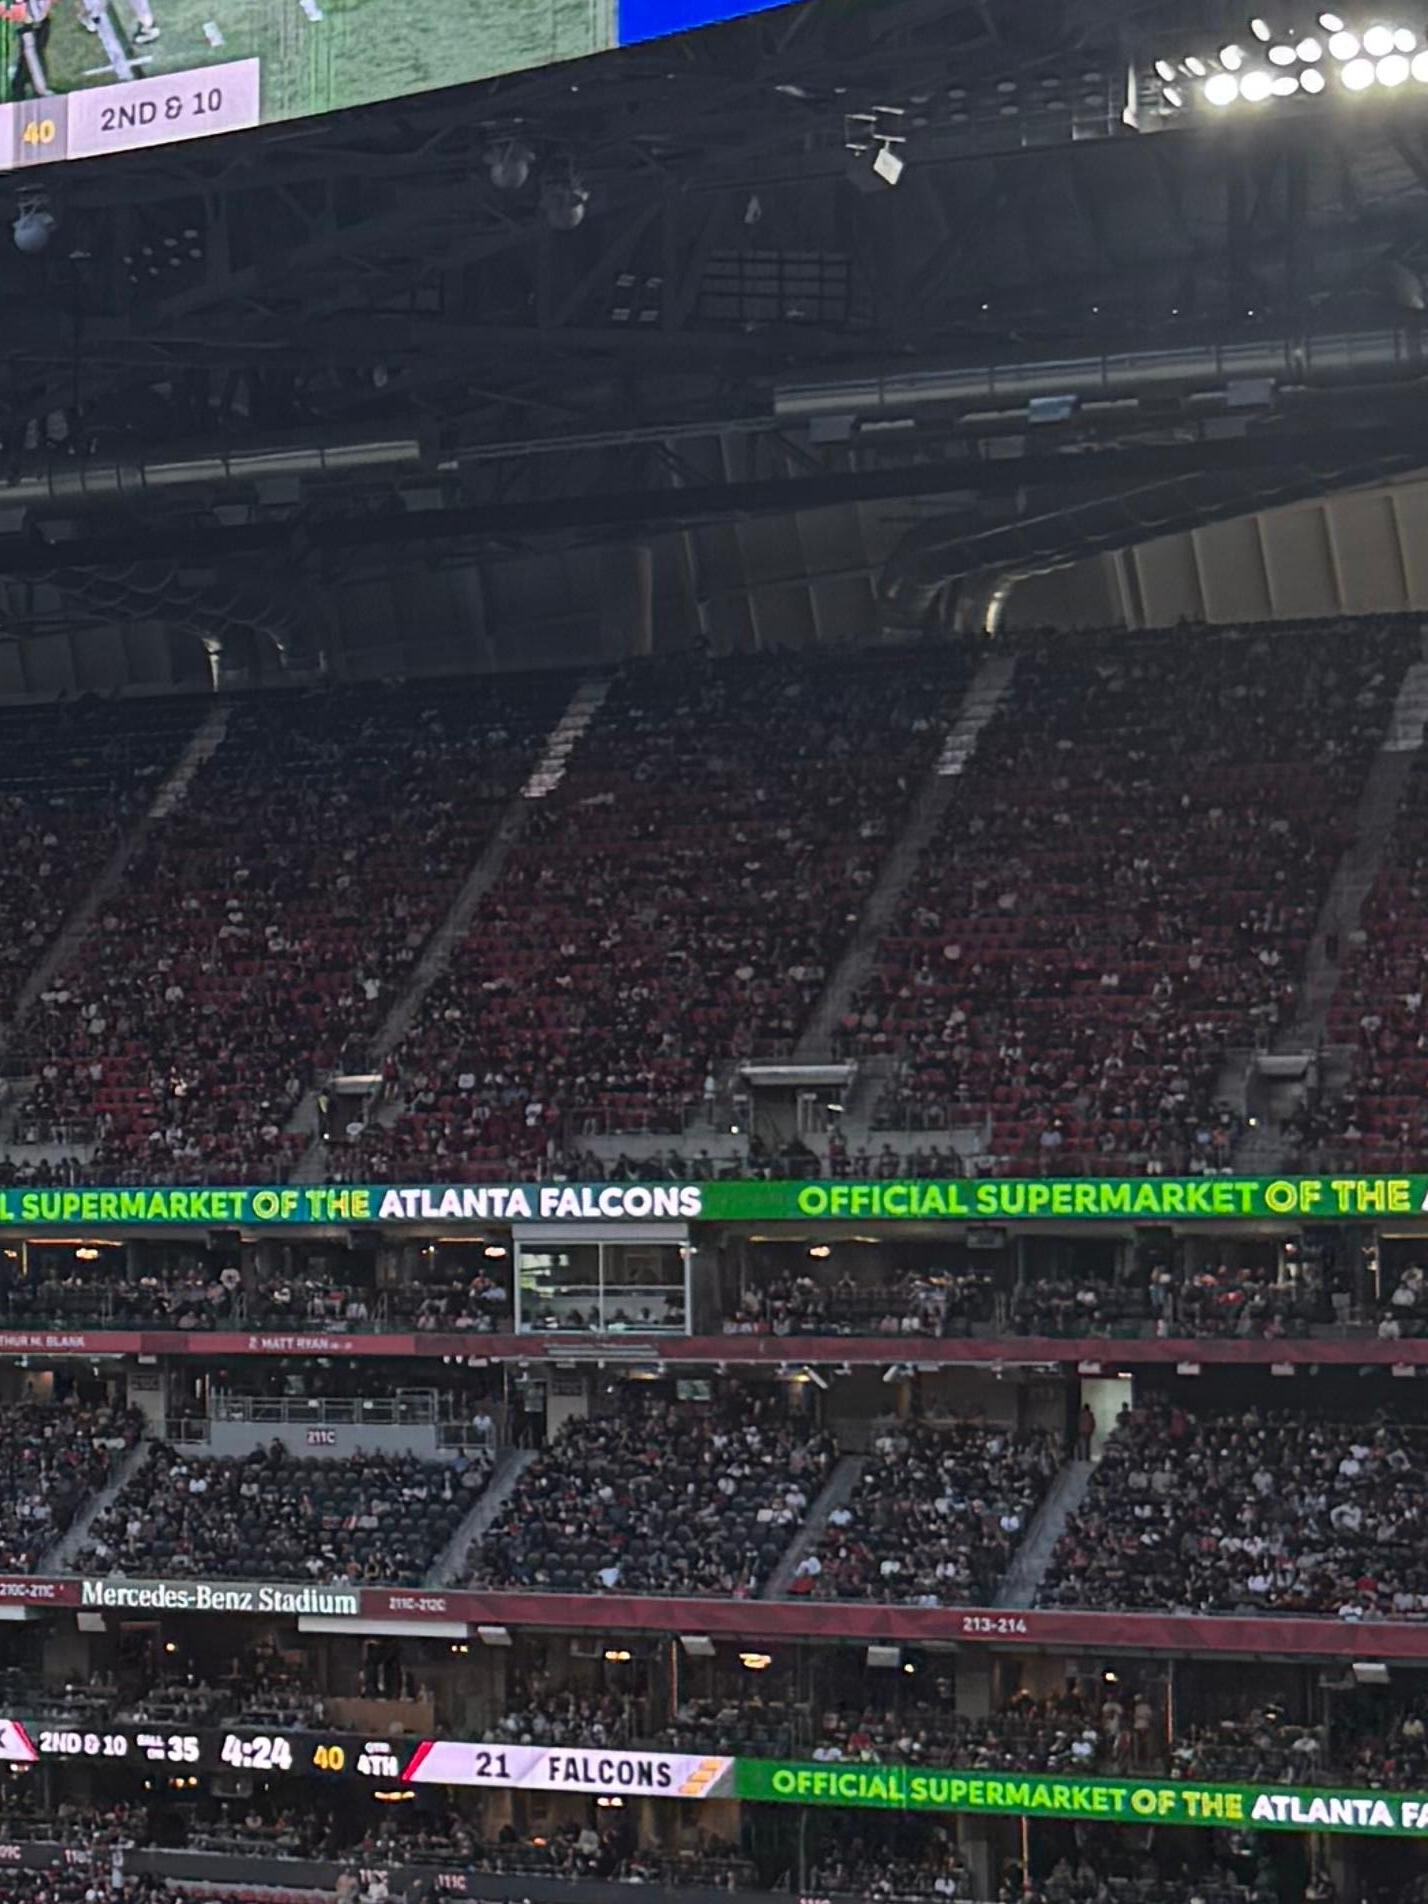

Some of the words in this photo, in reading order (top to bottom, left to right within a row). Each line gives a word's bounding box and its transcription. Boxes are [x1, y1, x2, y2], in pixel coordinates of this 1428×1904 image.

[24, 120, 55, 146] 40
[100, 104, 157, 132] 2ND
[192, 88, 223, 115] 10
[22, 1191, 244, 1222] SUPERMARKET
[253, 1192, 297, 1219] OF
[306, 1191, 370, 1219] THE
[379, 1188, 530, 1219] ATLANTA
[540, 1186, 700, 1217] FALCONS
[798, 1186, 967, 1215] OFFICIAL
[977, 1183, 1257, 1215] SUPERMARKET
[1264, 1181, 1321, 1211] OF
[1333, 1181, 1411, 1211] THE
[82, 1581, 251, 1612] Mercedes-Benz
[259, 1586, 357, 1615] Stadium
[963, 1617, 1027, 1633] 213-214
[40, 1733, 81, 1754] 2ND
[103, 1735, 126, 1756] 10
[167, 1736, 198, 1762] 35
[221, 1734, 292, 1769] 4:24
[314, 1745, 343, 1769] 40
[357, 1753, 397, 1777] 4TH
[476, 1752, 510, 1778] 21
[548, 1756, 671, 1787] FALCONS
[772, 1770, 903, 1800] OFFICIAL
[910, 1776, 1125, 1812] SUPERMARKET
[1131, 1788, 1174, 1815] OF
[1182, 1789, 1242, 1817] THE
[1251, 1795, 1393, 1827] ATLANTA
